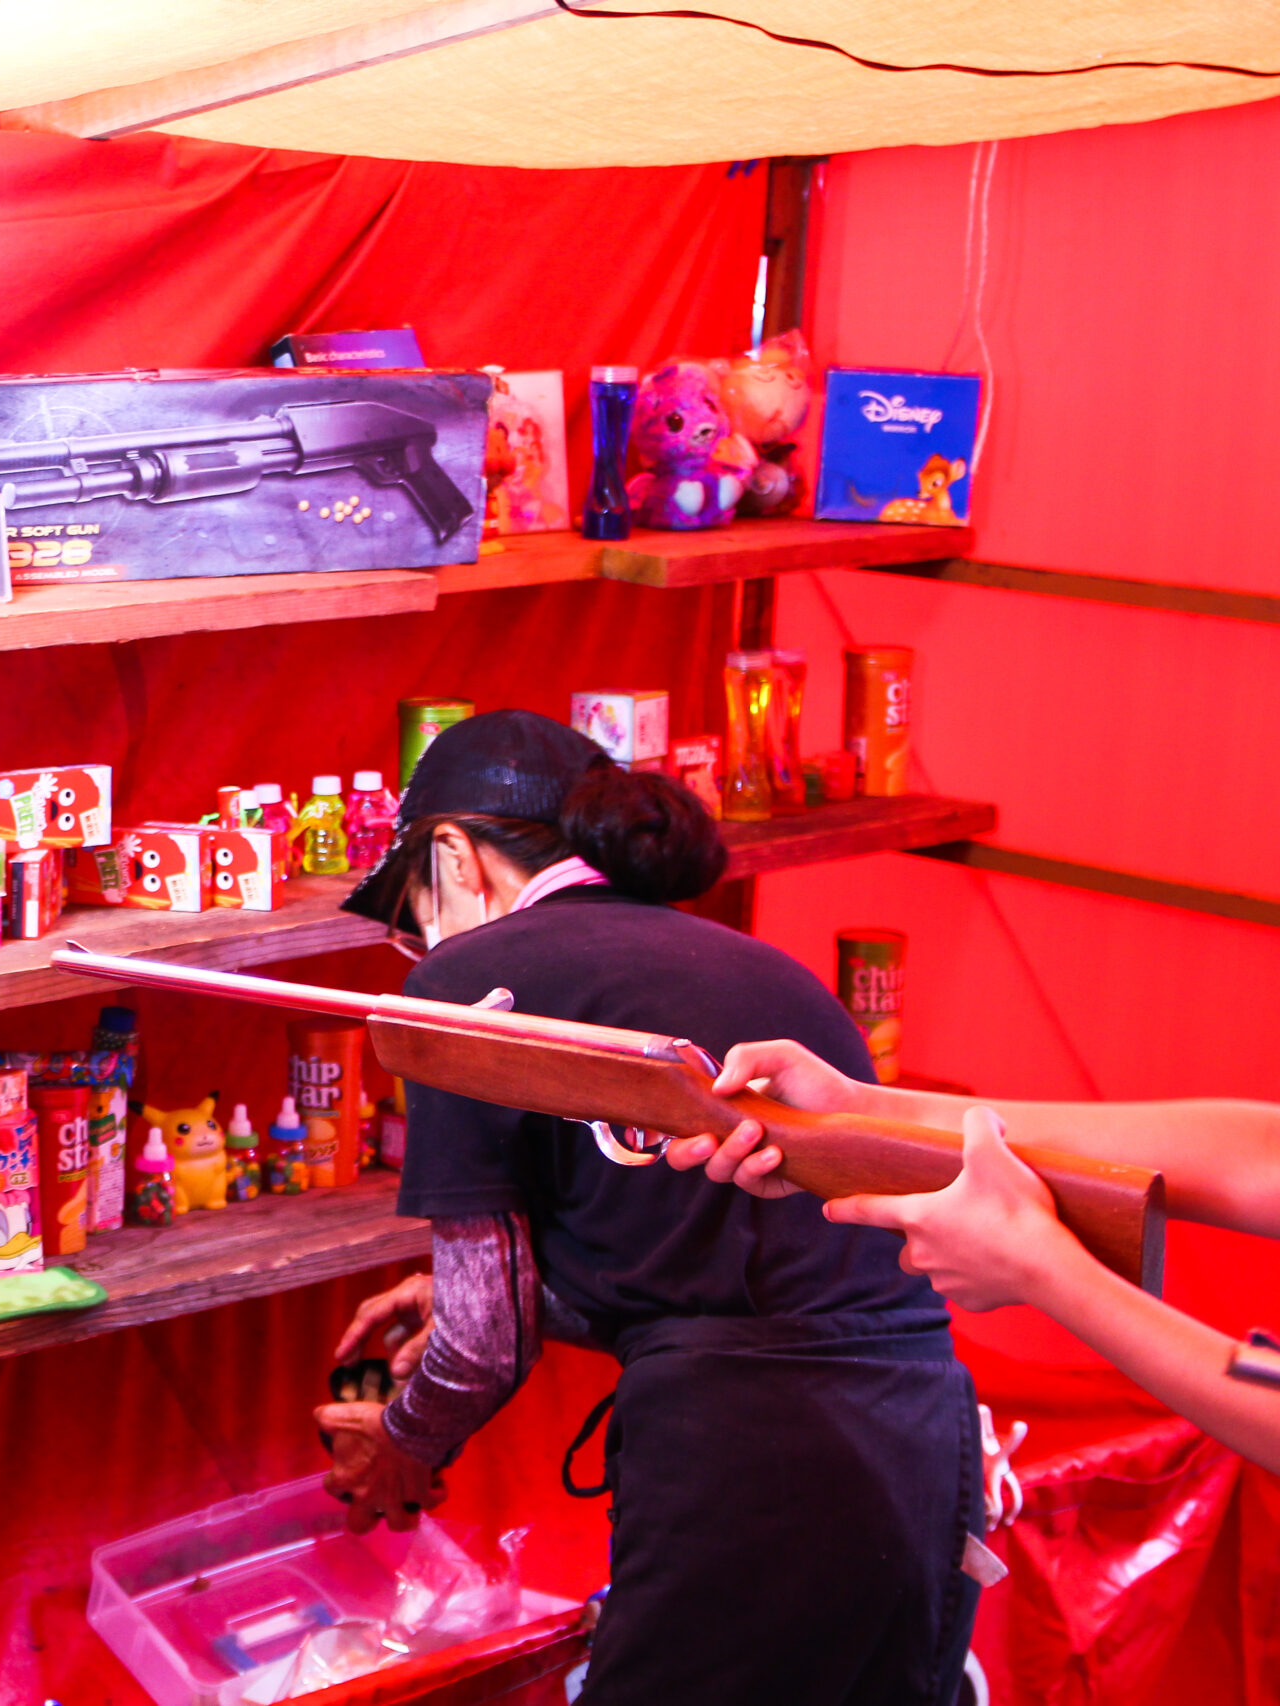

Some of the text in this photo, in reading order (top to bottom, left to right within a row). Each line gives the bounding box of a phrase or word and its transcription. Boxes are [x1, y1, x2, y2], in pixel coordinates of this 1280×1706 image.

[858, 389, 943, 434] Disney
[22, 525, 63, 537] SOFT
[65, 524, 100, 536] GUN
[290, 1055, 342, 1084] hip
